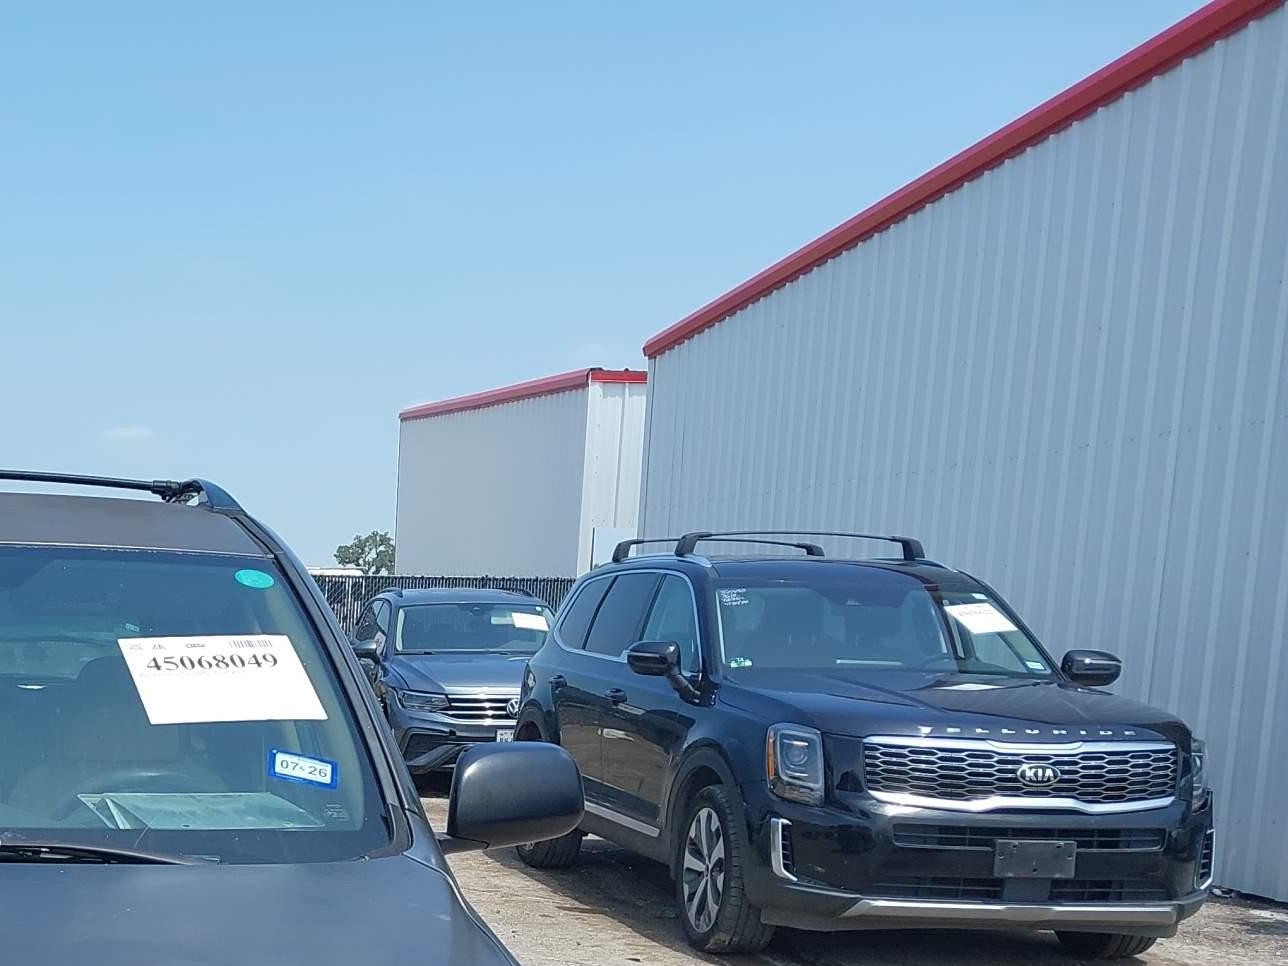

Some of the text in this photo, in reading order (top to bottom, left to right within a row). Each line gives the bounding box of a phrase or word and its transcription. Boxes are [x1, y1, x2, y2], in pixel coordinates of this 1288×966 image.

[146, 653, 278, 671] 45068049
[917, 725, 1137, 737] TELLURIDE
[1025, 767, 1055, 781] KIA
